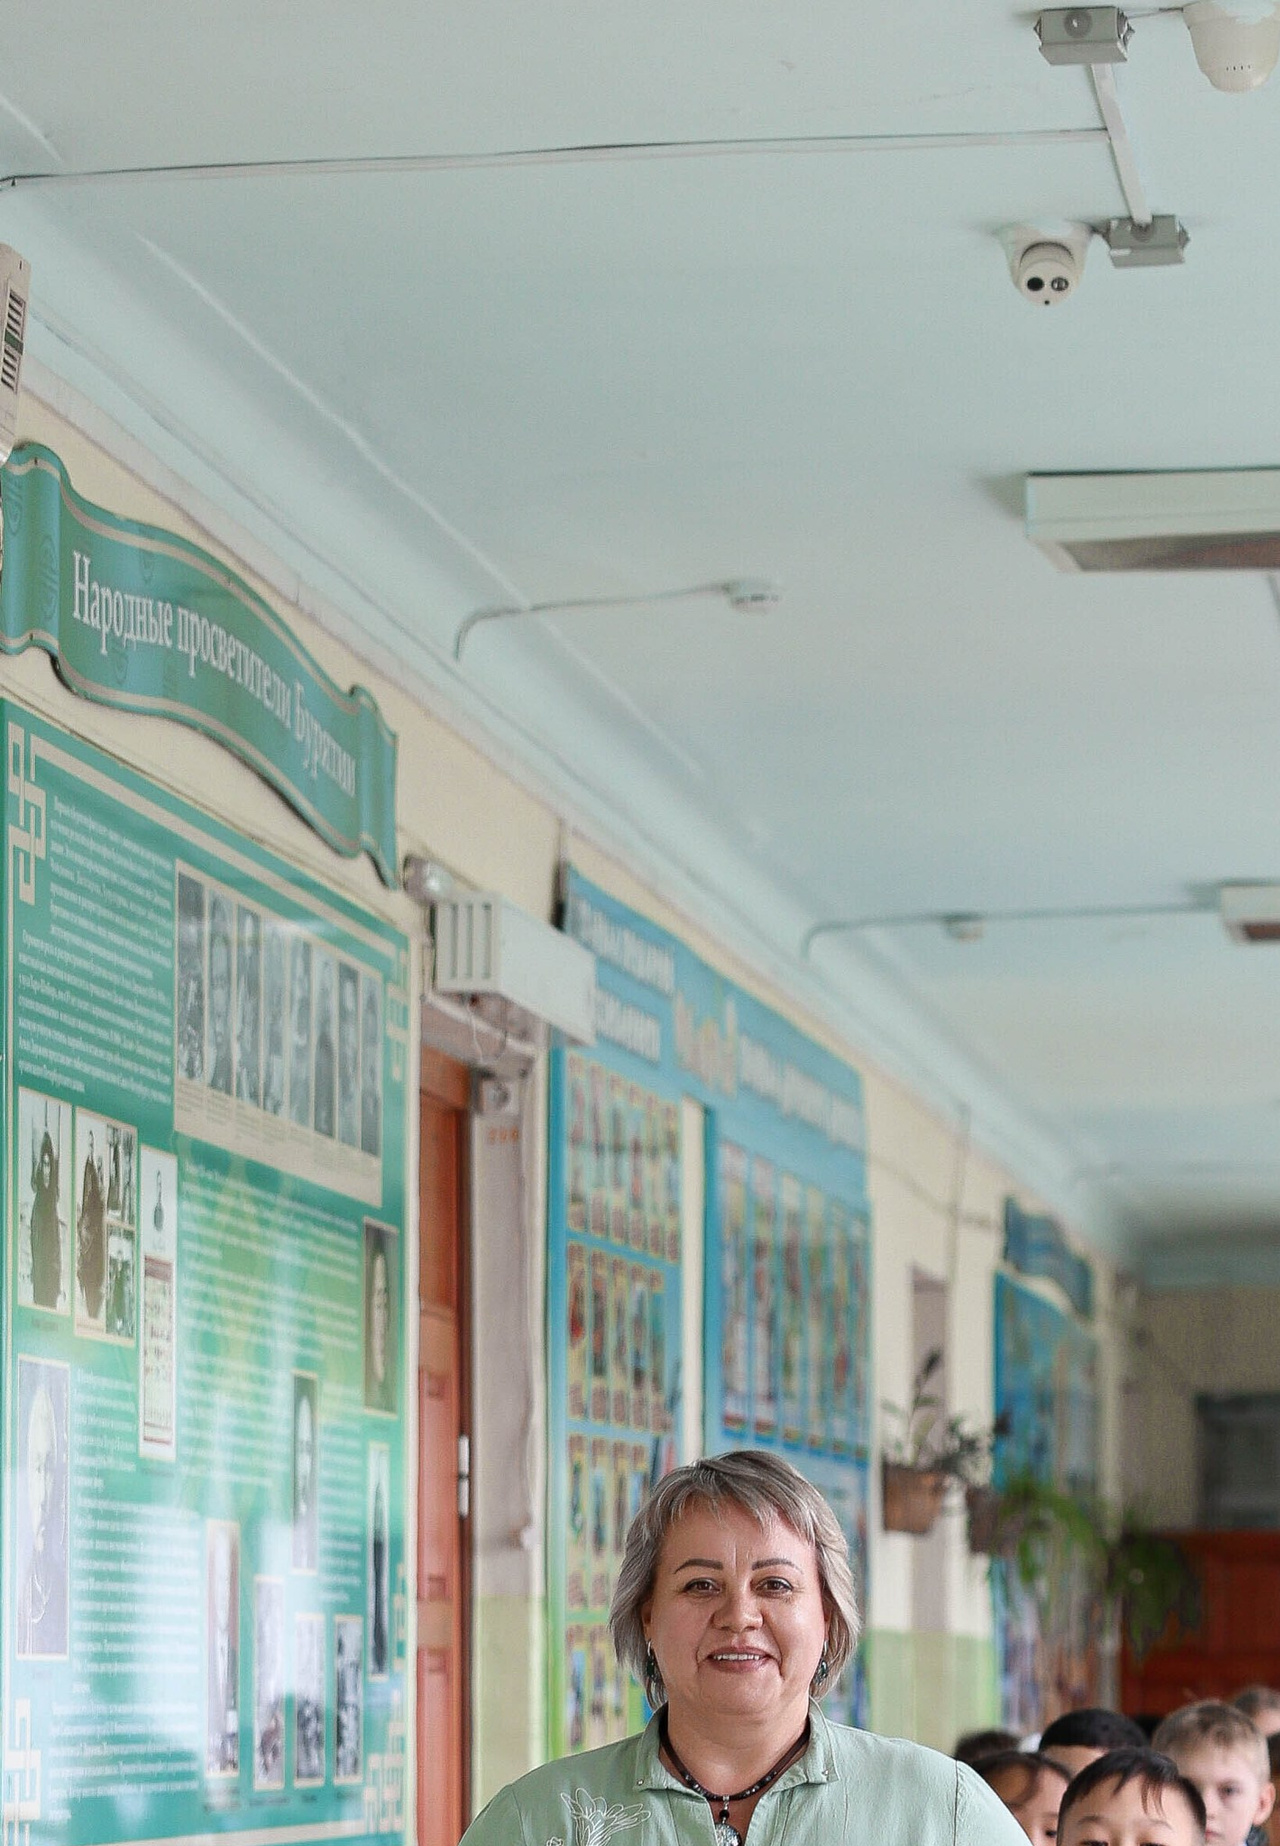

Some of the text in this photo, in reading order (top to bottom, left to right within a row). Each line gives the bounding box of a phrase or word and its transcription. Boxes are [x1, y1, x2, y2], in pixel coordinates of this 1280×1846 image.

[73, 550, 356, 798] Народные просветители Бурятии
